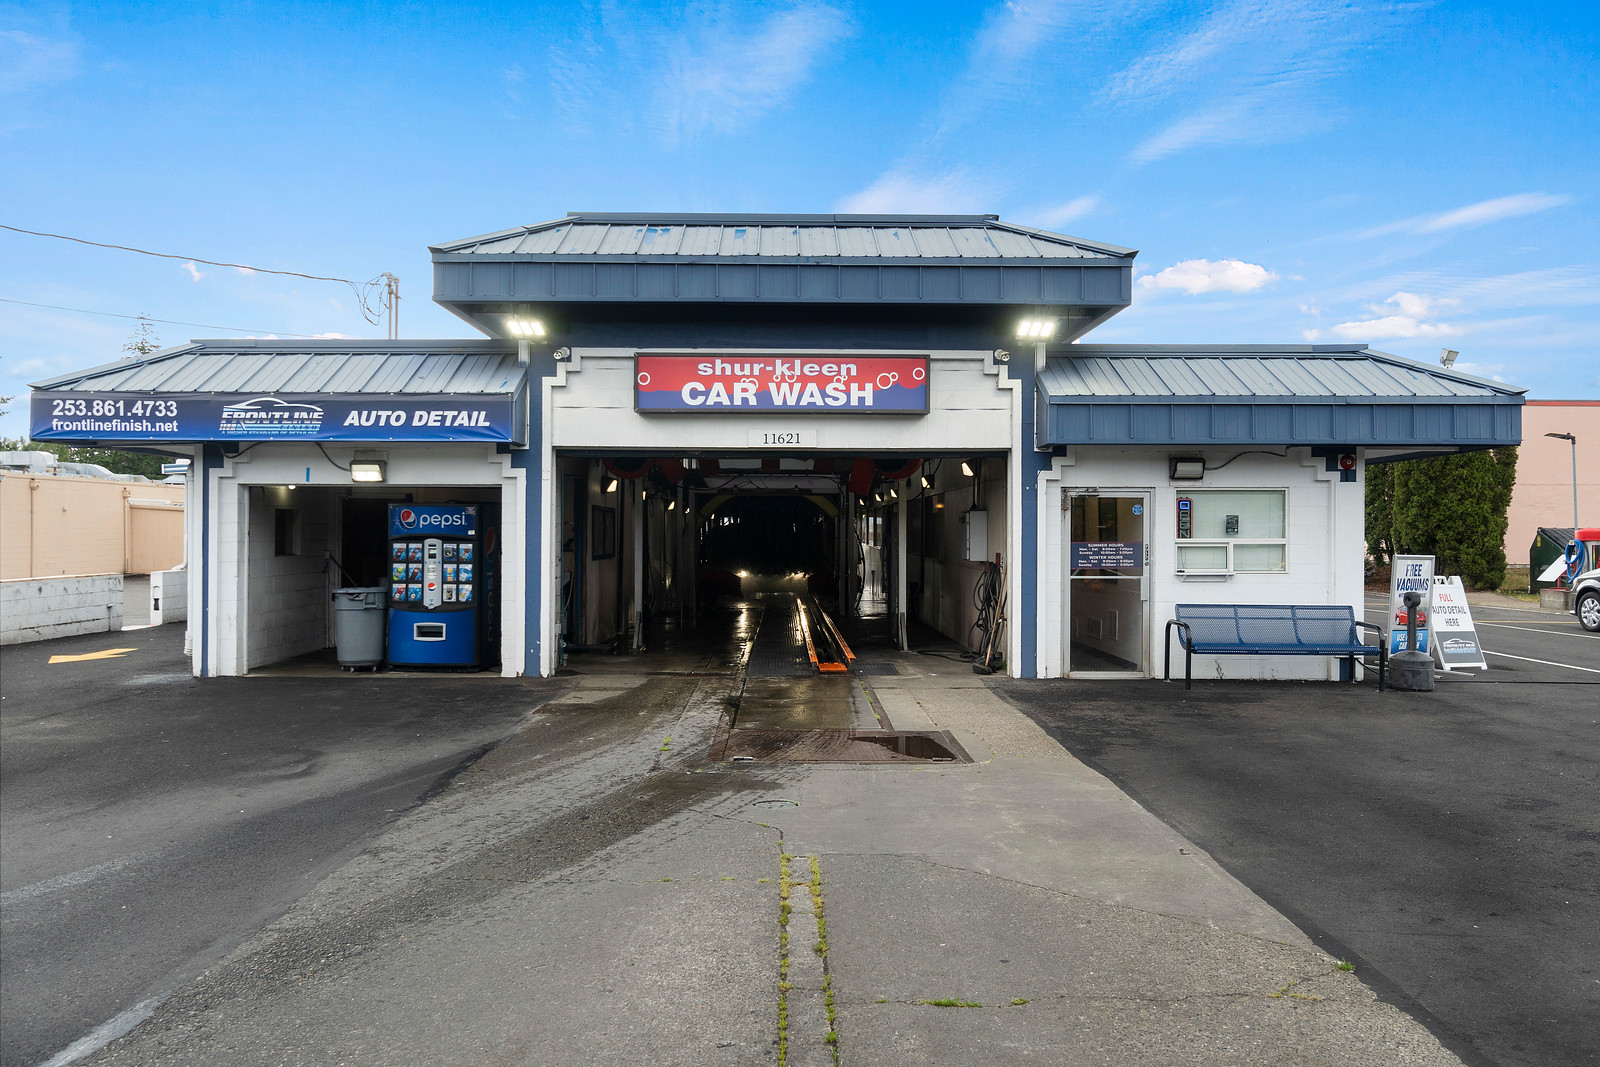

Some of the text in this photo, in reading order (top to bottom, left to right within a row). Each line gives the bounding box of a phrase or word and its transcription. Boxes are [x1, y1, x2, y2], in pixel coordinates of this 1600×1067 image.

[697, 359, 857, 376] shur-kleen
[681, 382, 874, 407] CAR WASH
[52, 400, 178, 417] 253.861.4733
[221, 412, 324, 424] FRONTLINE
[343, 410, 491, 427] AUTO DETAIL
[51, 418, 179, 433] frontlinefinish.net
[763, 433, 801, 444] 11621
[419, 512, 466, 528] pepsi
[1179, 501, 1190, 538] OPEN
[1406, 564, 1422, 576] FREE
[1396, 578, 1429, 591] VACUUMS
[1439, 594, 1453, 602] FULL
[1432, 605, 1467, 614] AUTO DETAIL
[1445, 618, 1460, 626] HERE
